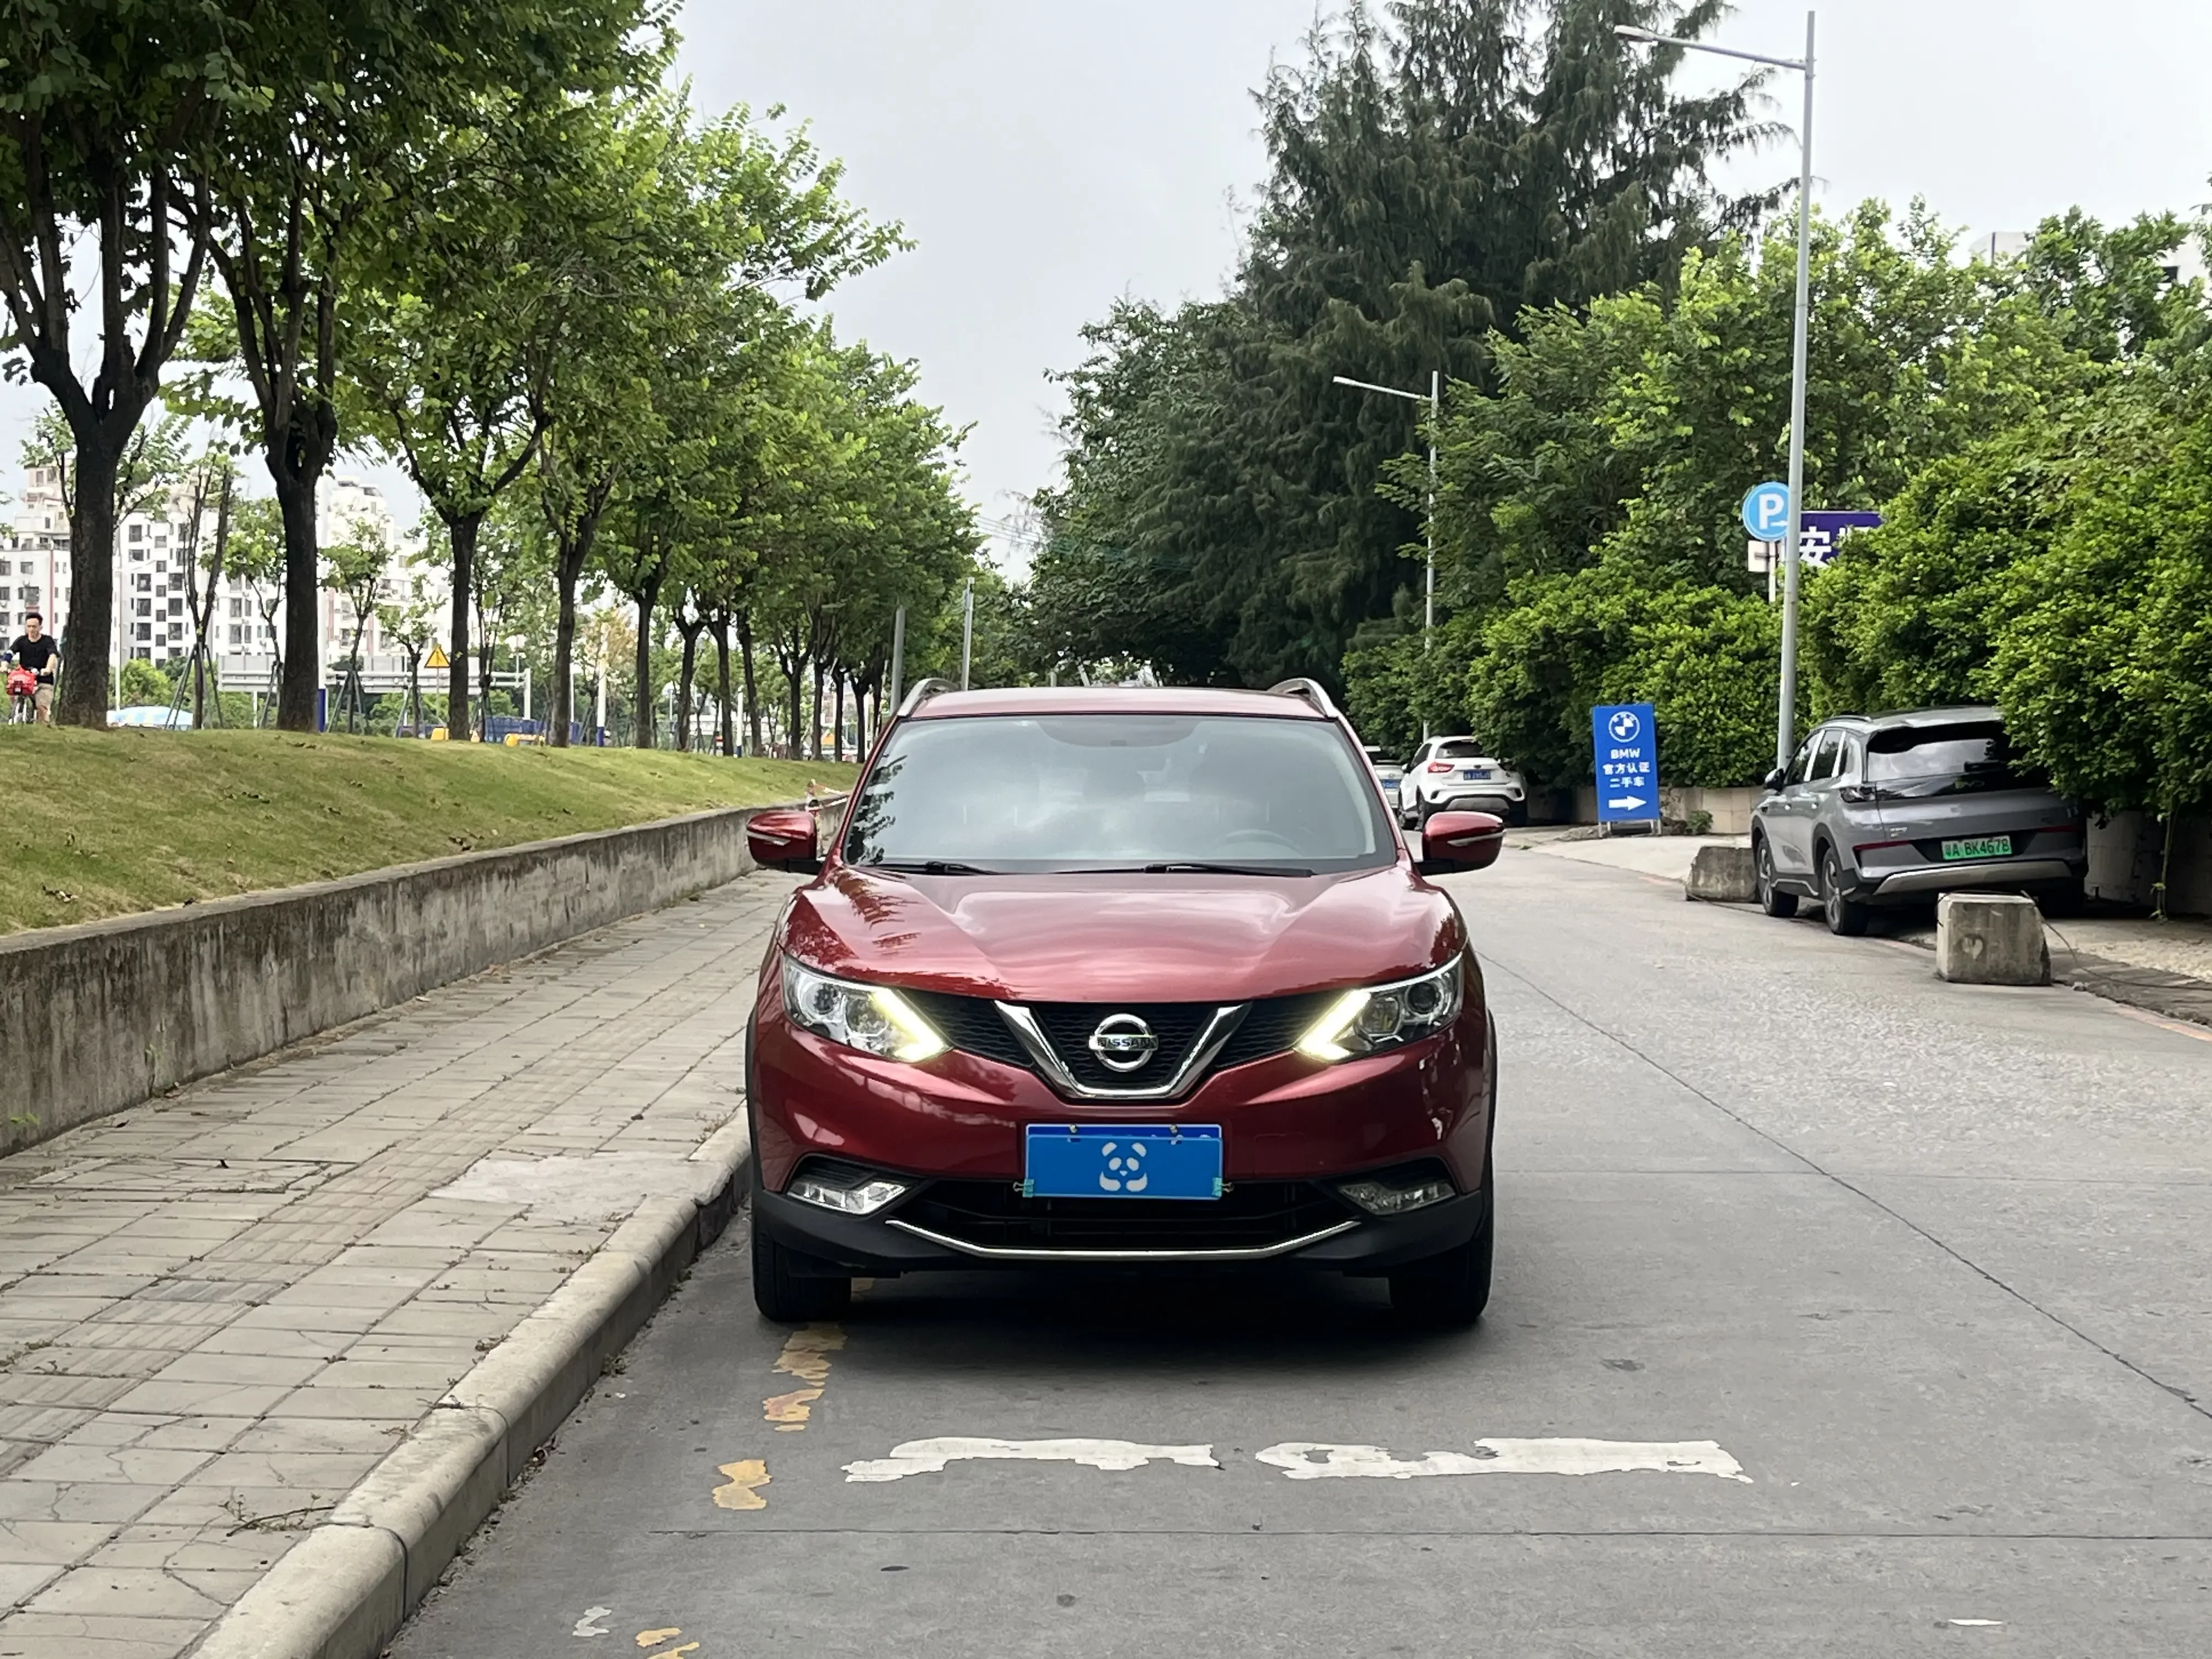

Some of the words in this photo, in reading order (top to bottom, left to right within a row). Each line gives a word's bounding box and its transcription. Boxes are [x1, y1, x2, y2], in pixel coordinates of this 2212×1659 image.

[1759, 493, 1784, 529] P
[1611, 748, 1640, 759] BMW
[1603, 761, 1650, 775] 官方认证
[1610, 777, 1644, 788] 二手车
[1965, 838, 2009, 856] BK4678
[1098, 1037, 1151, 1048] NISSAN
